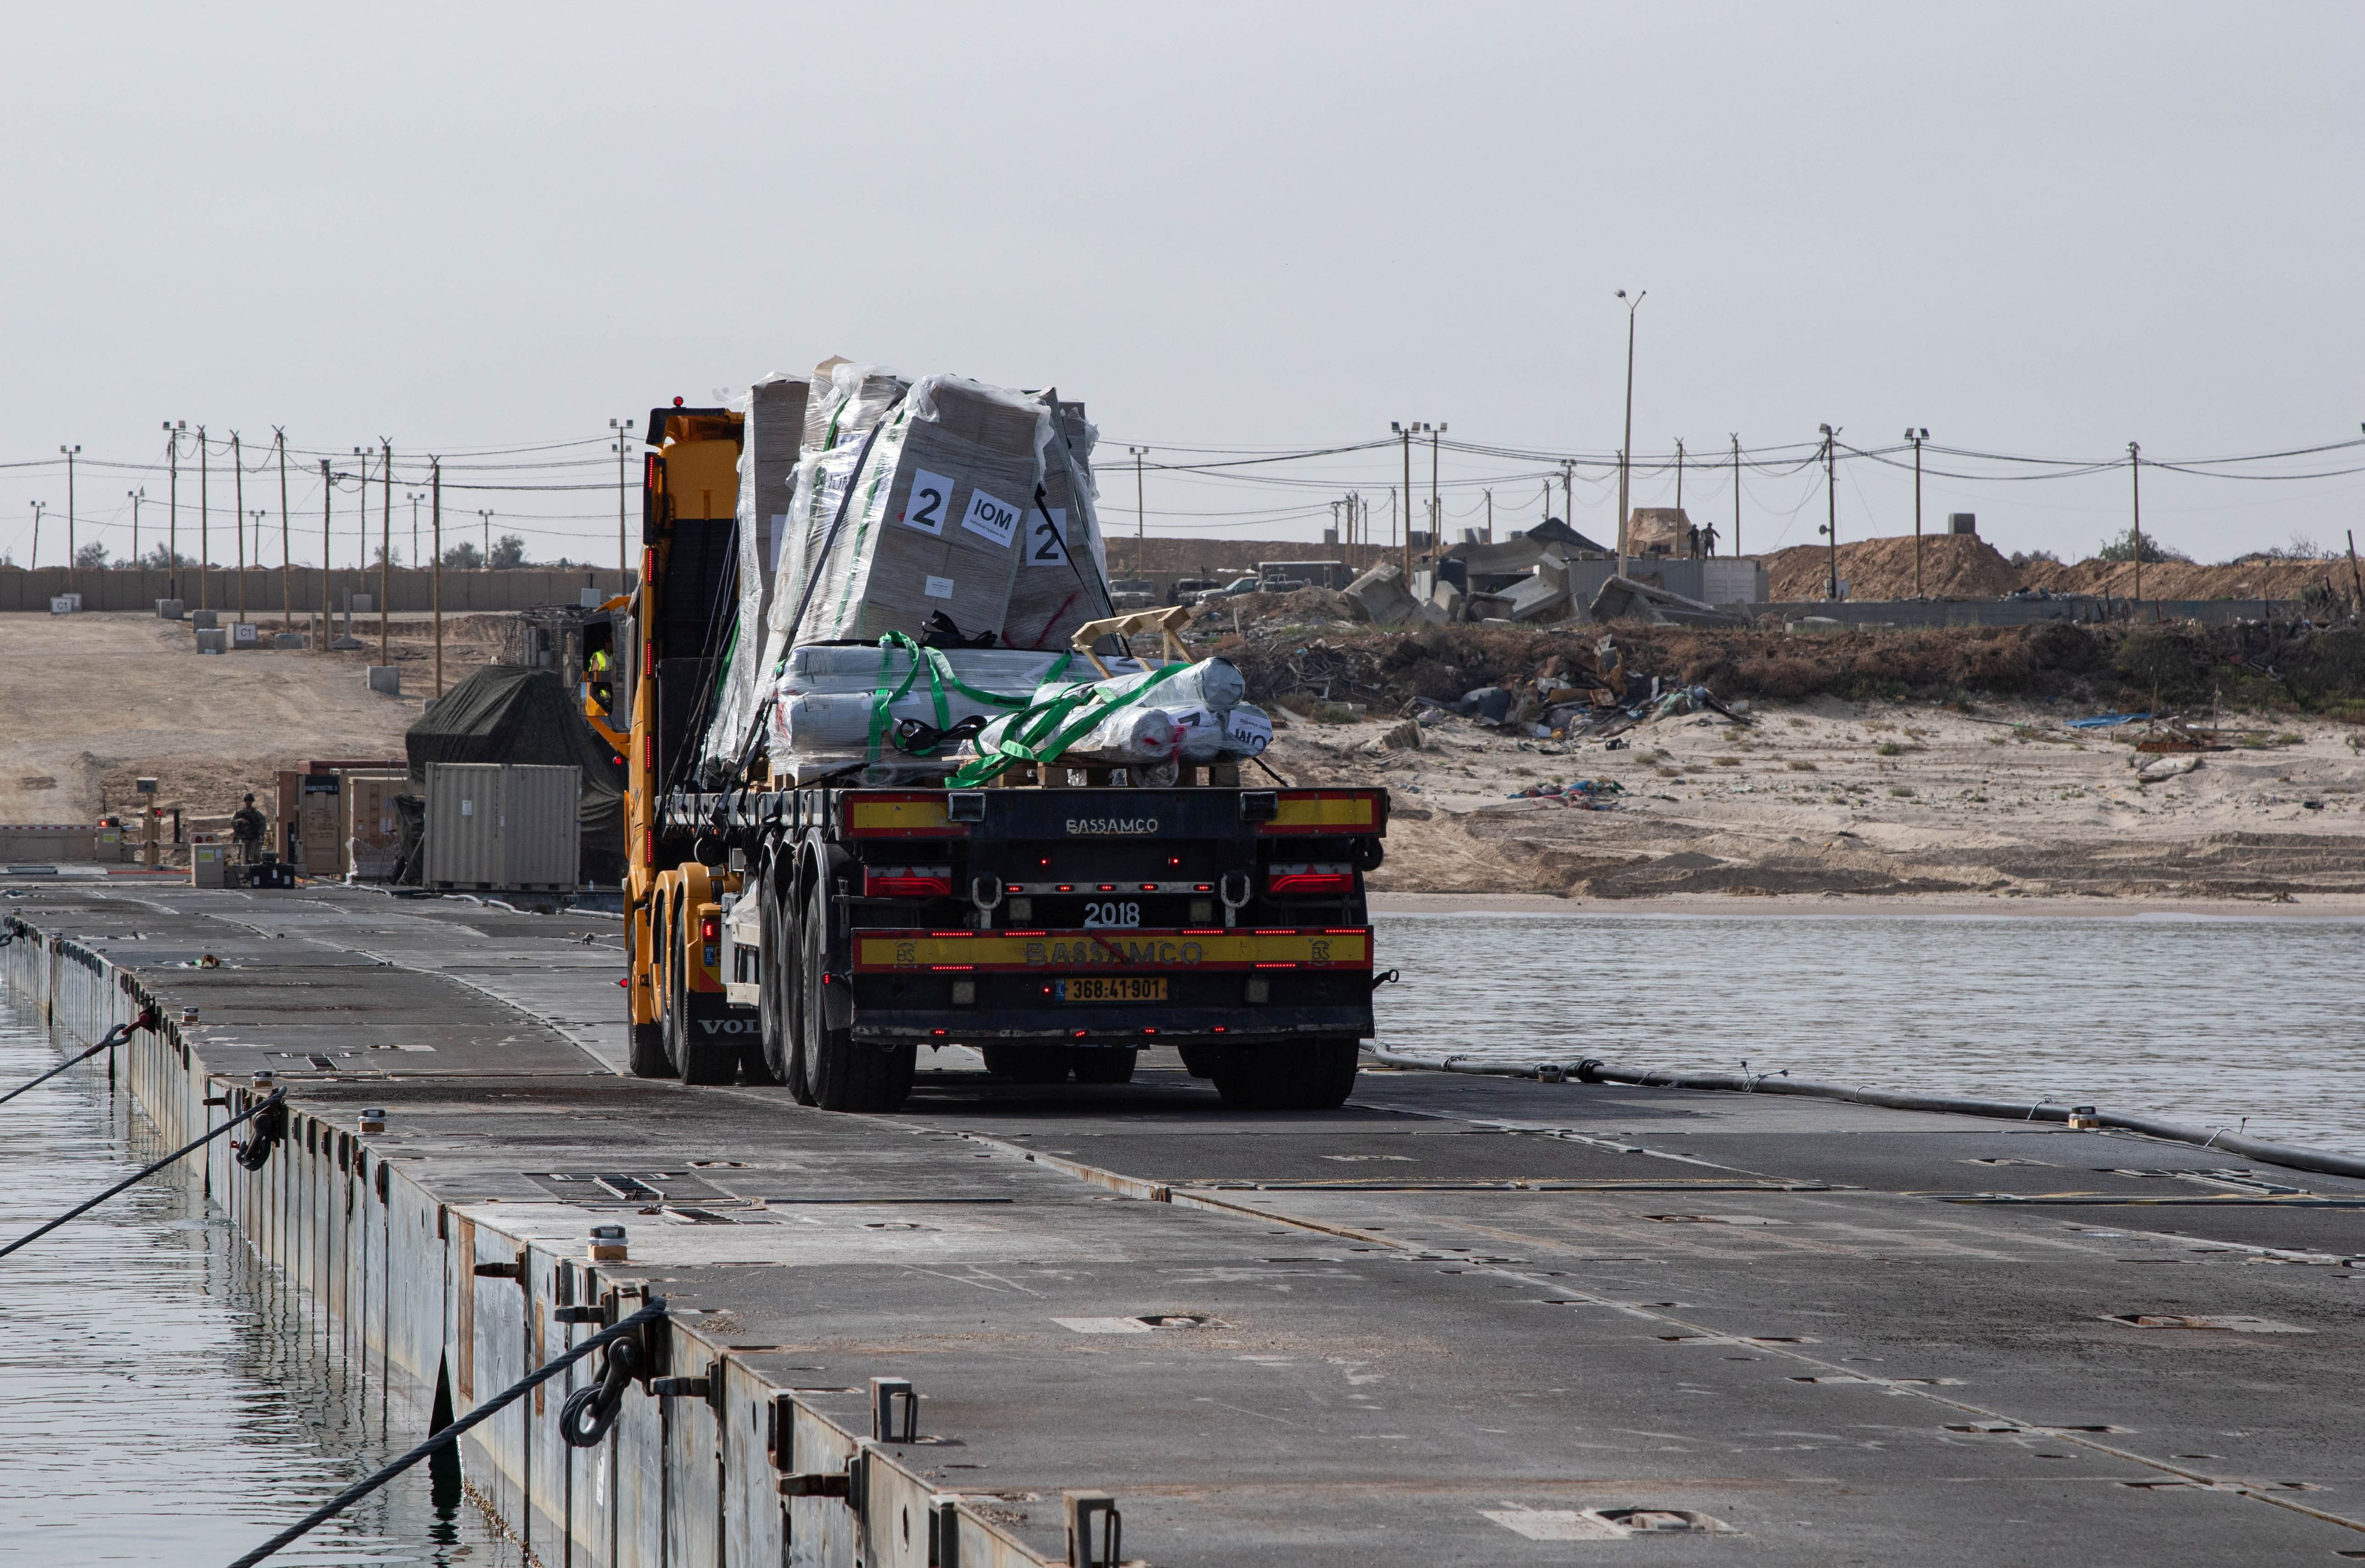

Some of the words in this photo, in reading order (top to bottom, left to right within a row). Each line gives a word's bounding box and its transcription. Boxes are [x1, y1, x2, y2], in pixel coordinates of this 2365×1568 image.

[912, 488, 941, 527] 2
[973, 499, 1013, 530] IOM
[1034, 524, 1059, 560] 2
[57, 601, 67, 610] C1
[241, 628, 251, 636] C1
[1066, 819, 1158, 834] BASSAMCO
[1084, 902, 1140, 927] 2018
[1026, 942, 1202, 965] BASSAMCO
[1056, 985, 1064, 993] IL
